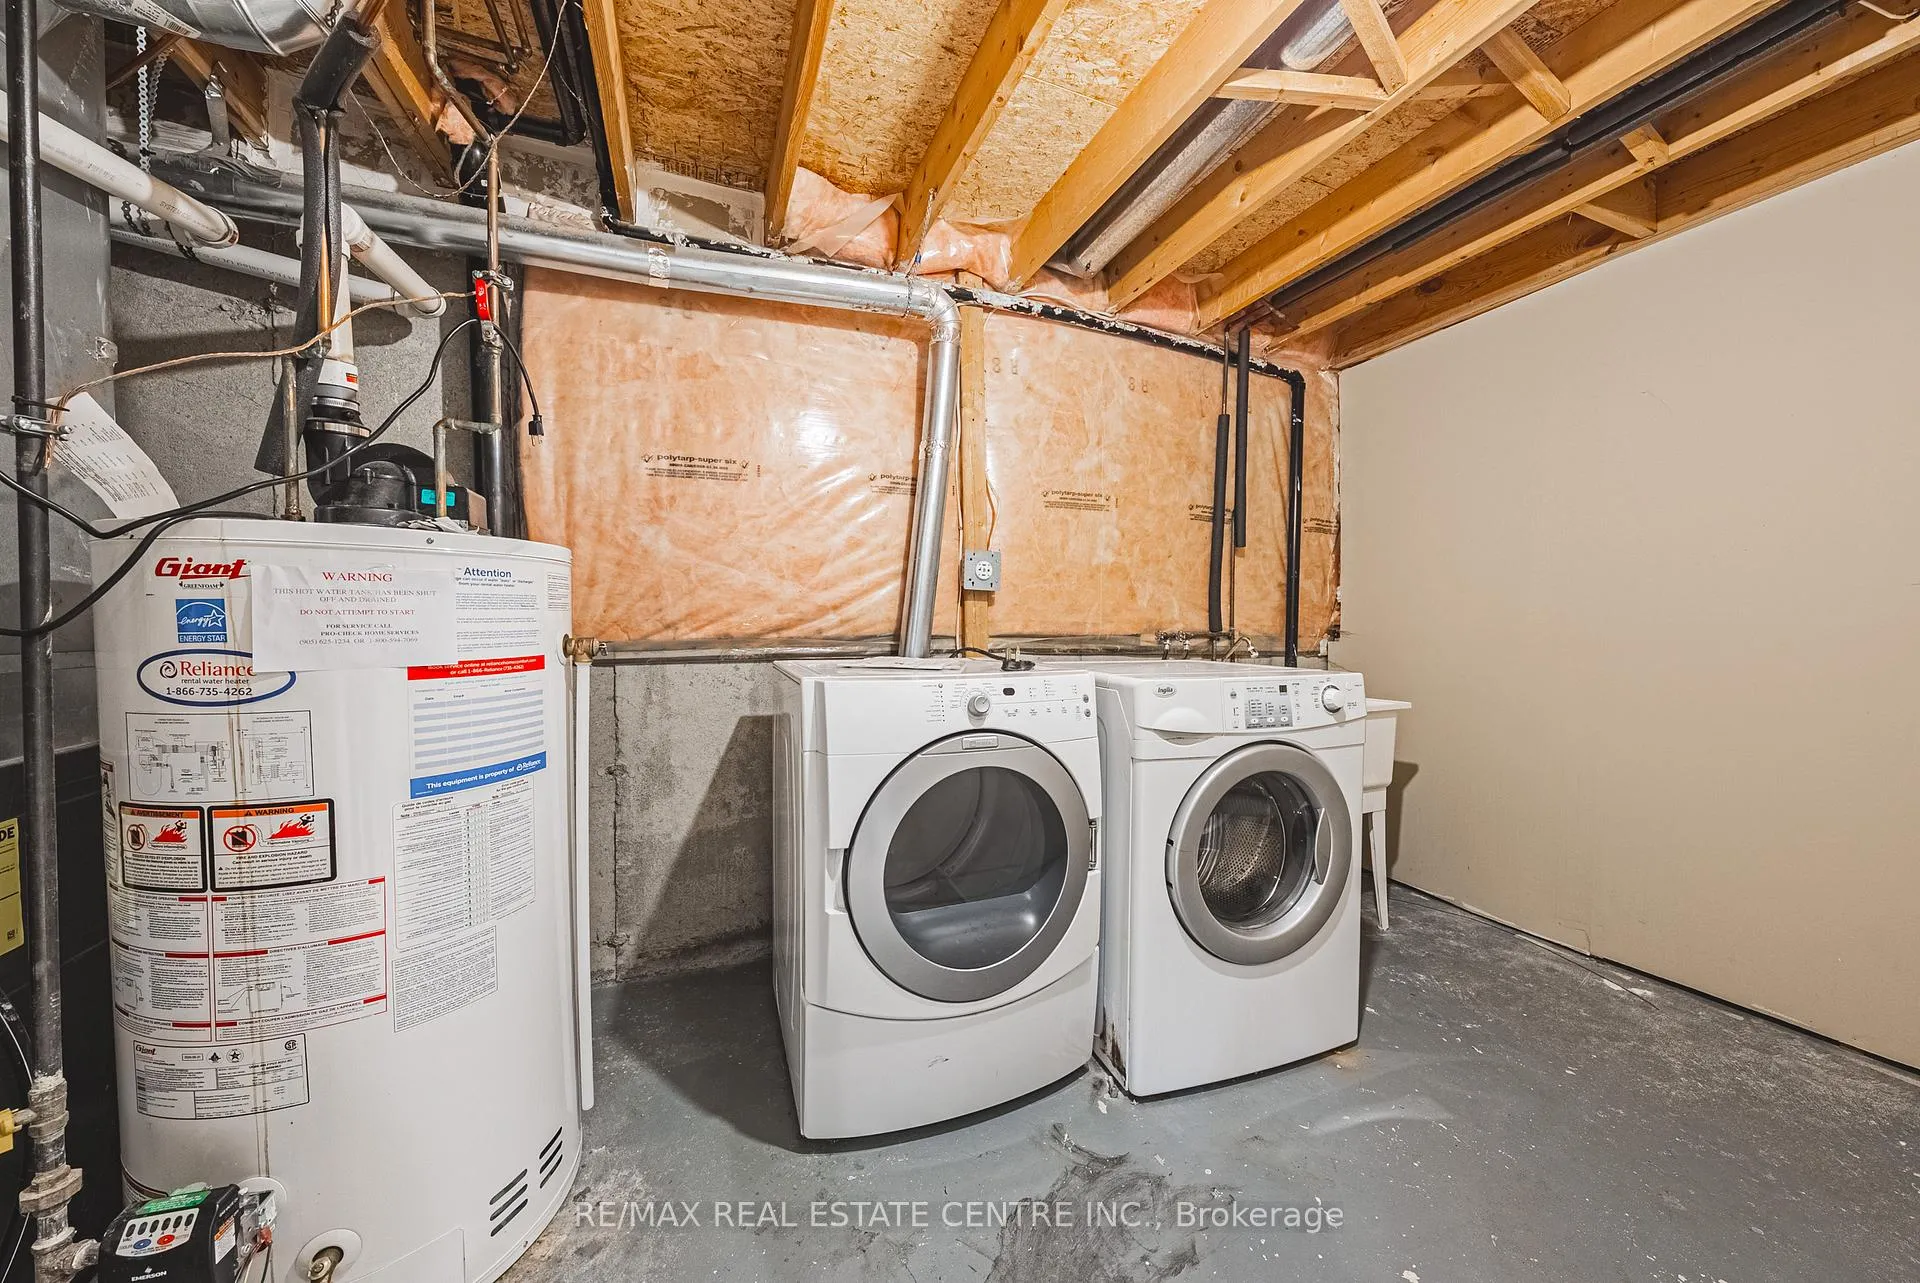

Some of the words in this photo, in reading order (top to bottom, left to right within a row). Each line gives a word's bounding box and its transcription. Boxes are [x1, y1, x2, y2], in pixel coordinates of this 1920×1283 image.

[155, 557, 251, 580] Giant
[464, 567, 512, 579] Attention
[322, 572, 393, 582] WARNING
[180, 661, 256, 677] Reliance
[167, 687, 252, 696] 1-866-735-4262
[426, 782, 442, 790] This
[443, 776, 478, 789] equipment
[485, 767, 509, 779] property
[255, 808, 295, 817] WARNING
[132, 1271, 167, 1282] EMERSON
